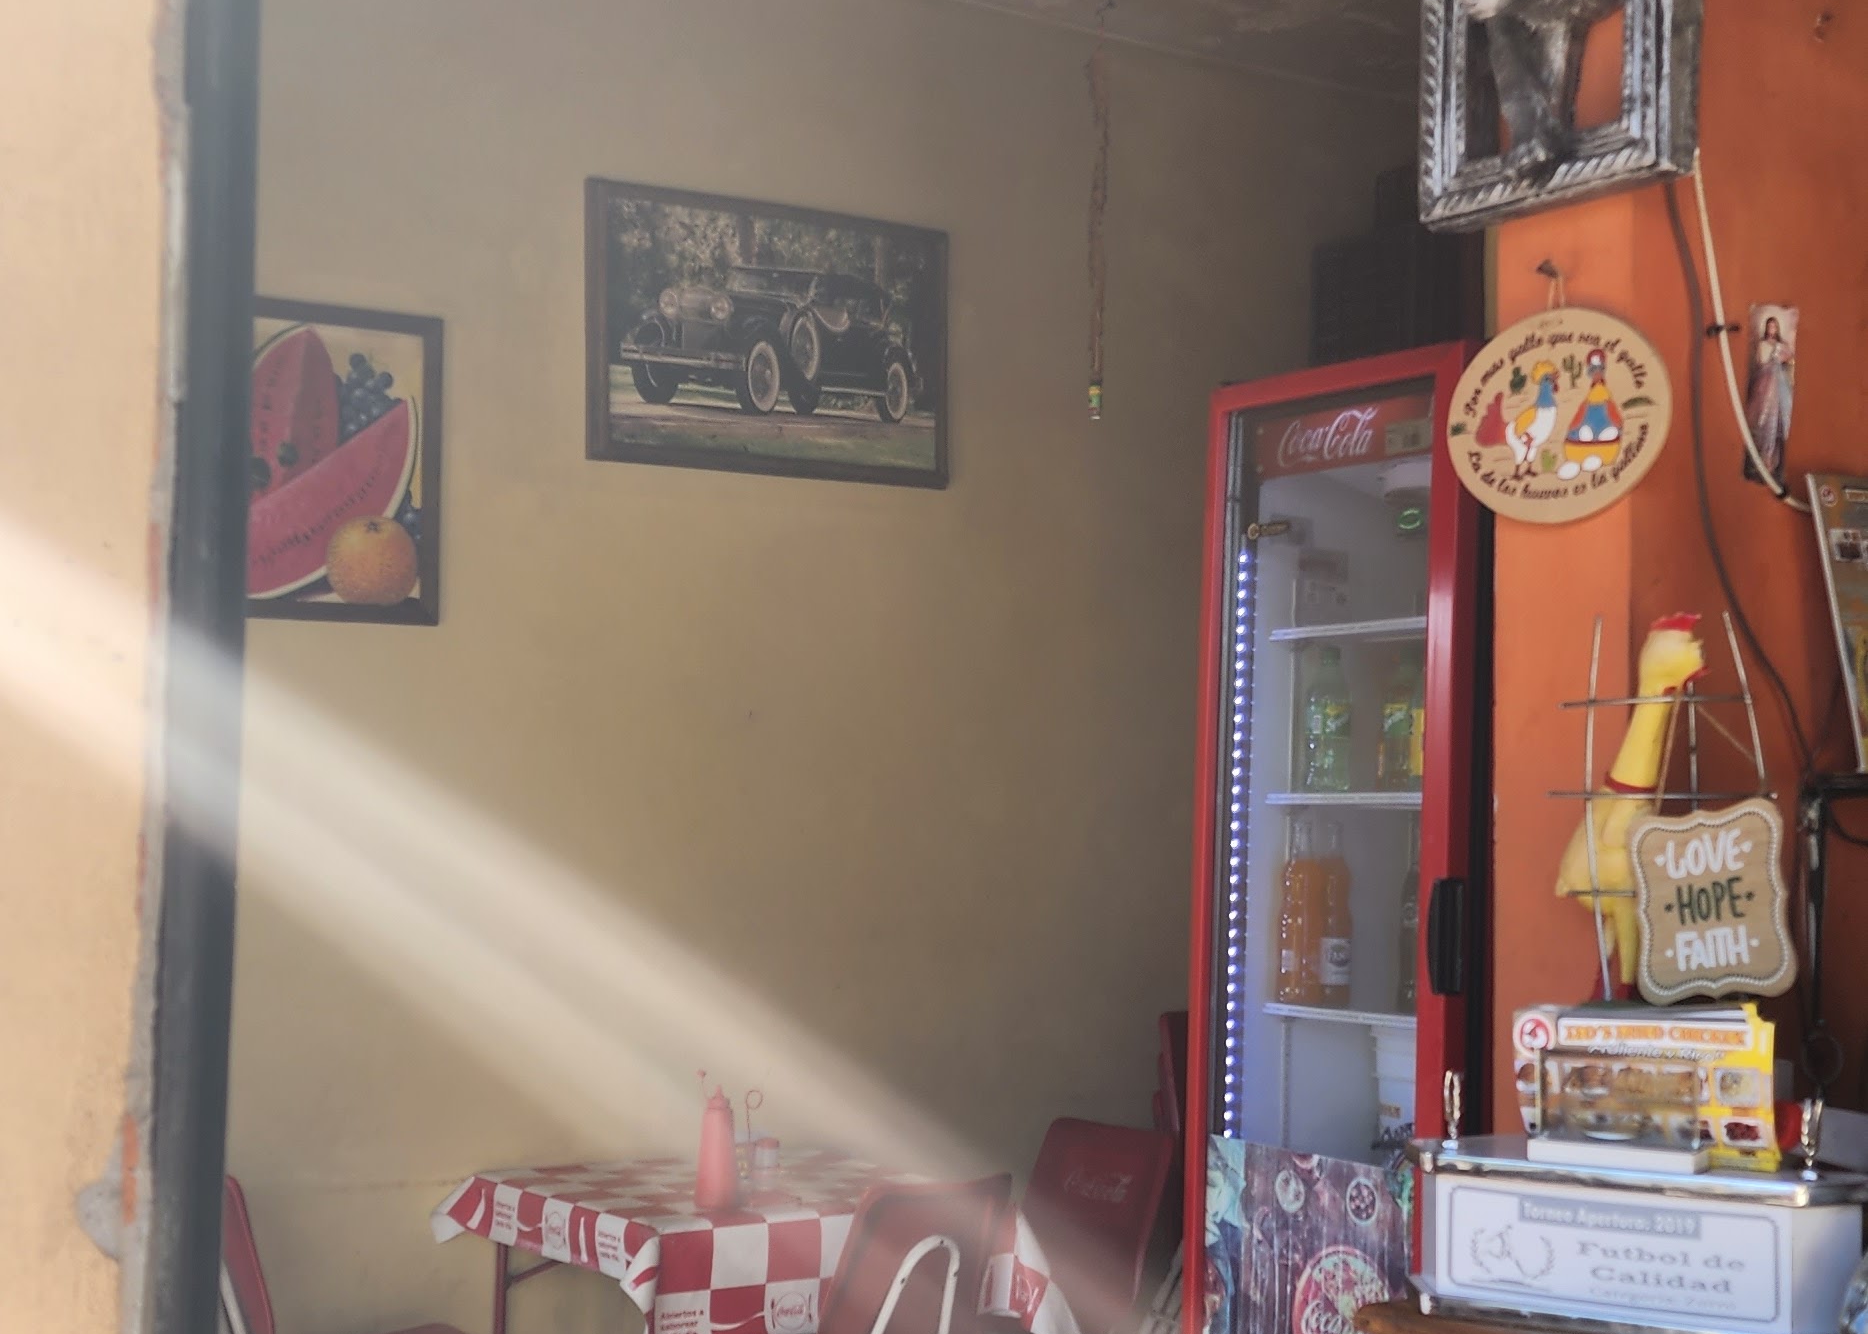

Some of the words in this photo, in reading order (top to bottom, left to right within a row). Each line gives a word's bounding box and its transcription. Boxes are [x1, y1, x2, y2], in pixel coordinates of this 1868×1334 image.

[1665, 828, 1745, 879] LOVE
[1676, 876, 1744, 926] HOPE
[1675, 925, 1750, 972] FAITH
[1577, 1240, 1692, 1268] Futbol
[1702, 1254, 1745, 1272] de
[1590, 1265, 1733, 1295] Calidad
